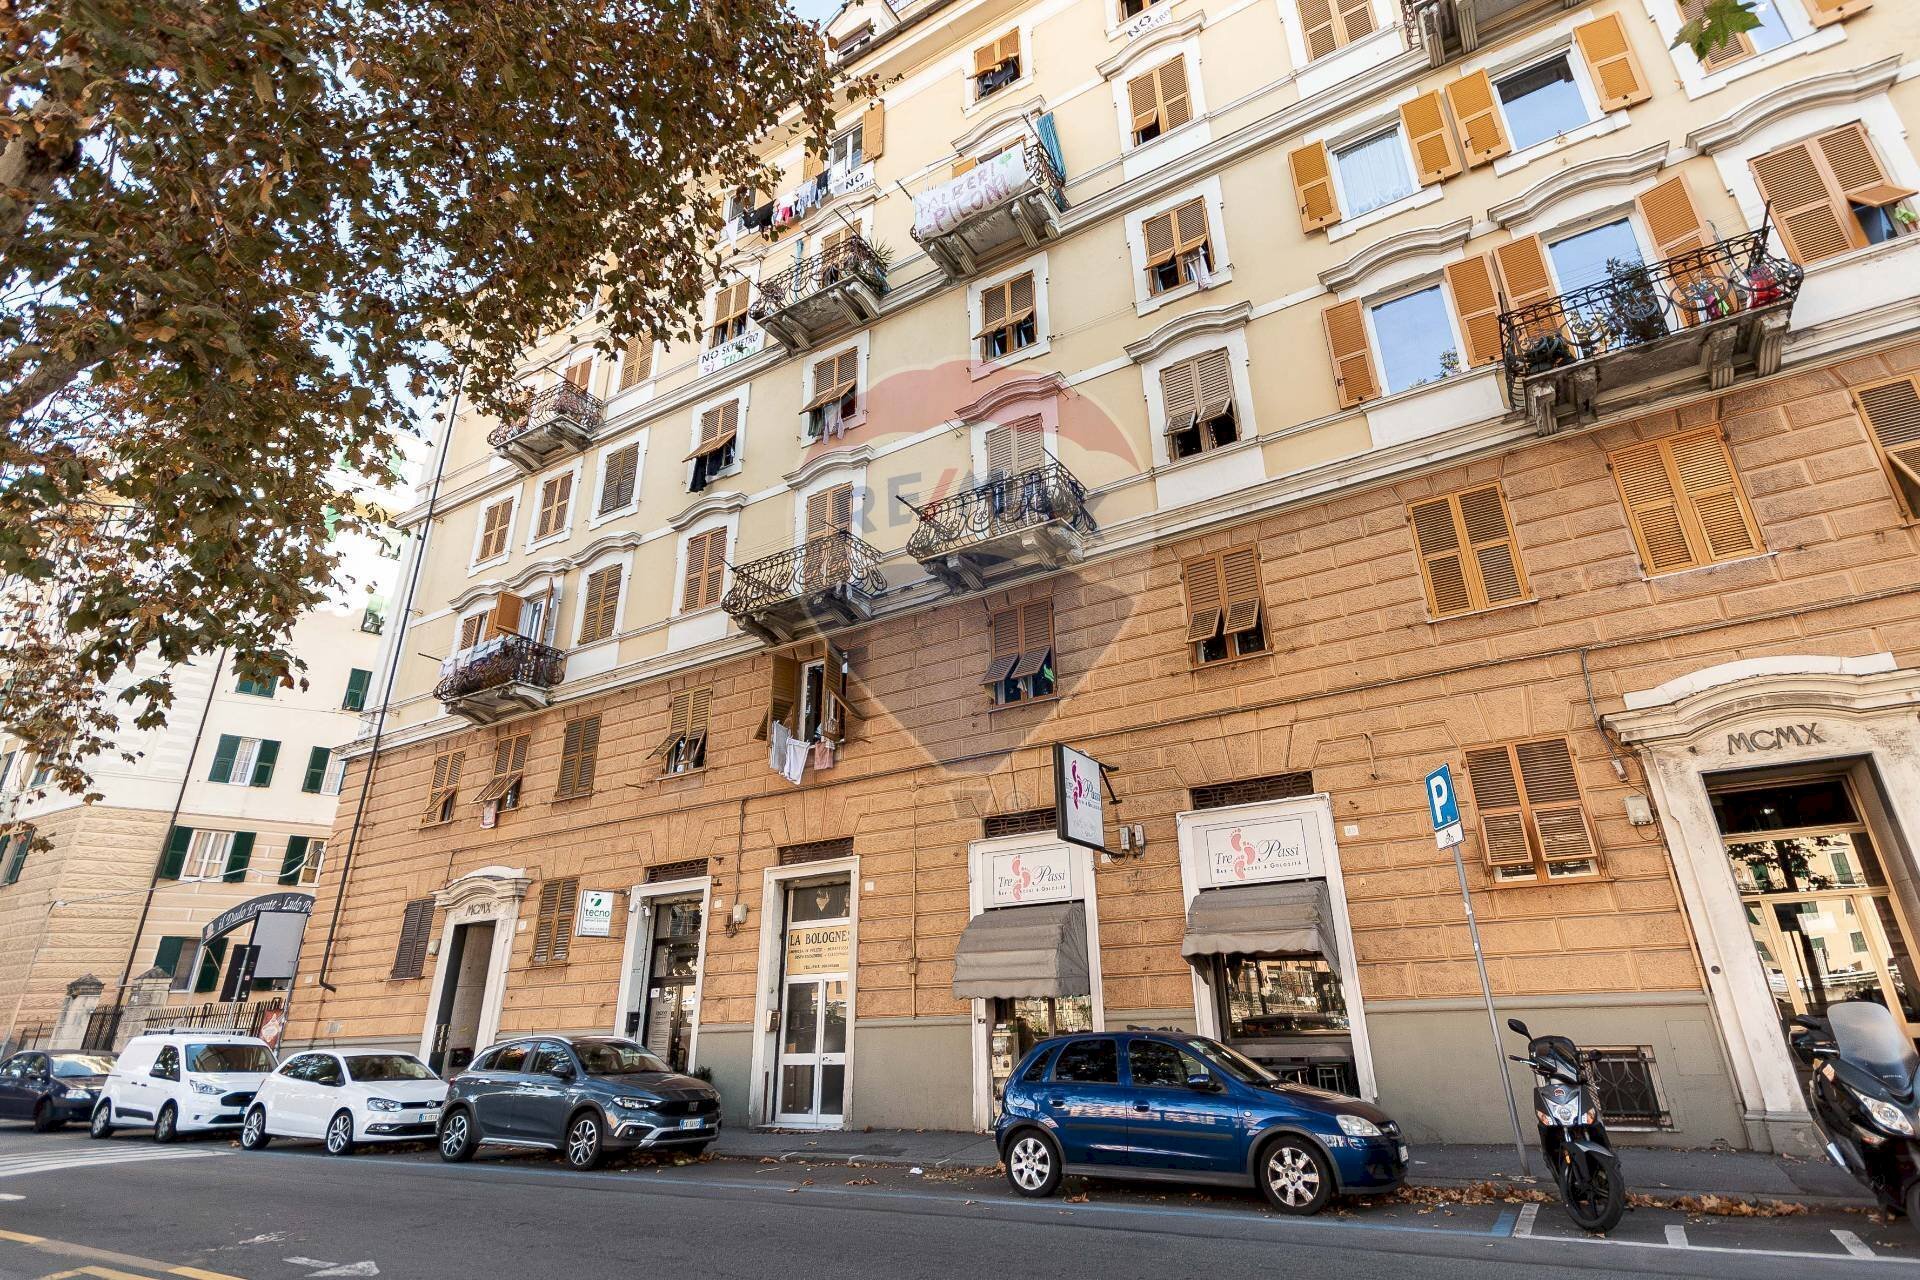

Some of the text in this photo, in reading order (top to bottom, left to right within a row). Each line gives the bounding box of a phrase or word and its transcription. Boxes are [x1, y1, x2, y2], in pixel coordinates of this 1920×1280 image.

[1127, 15, 1152, 37] NO
[845, 172, 864, 190] NO
[701, 350, 719, 364] NO
[1728, 722, 1827, 756] MCMX
[1430, 775, 1448, 823] P
[1215, 839, 1299, 865] Tre Passi
[998, 863, 1066, 888] Tre Passi
[464, 901, 493, 917] MCMX
[585, 909, 611, 918] tecno
[790, 934, 801, 946] LA
